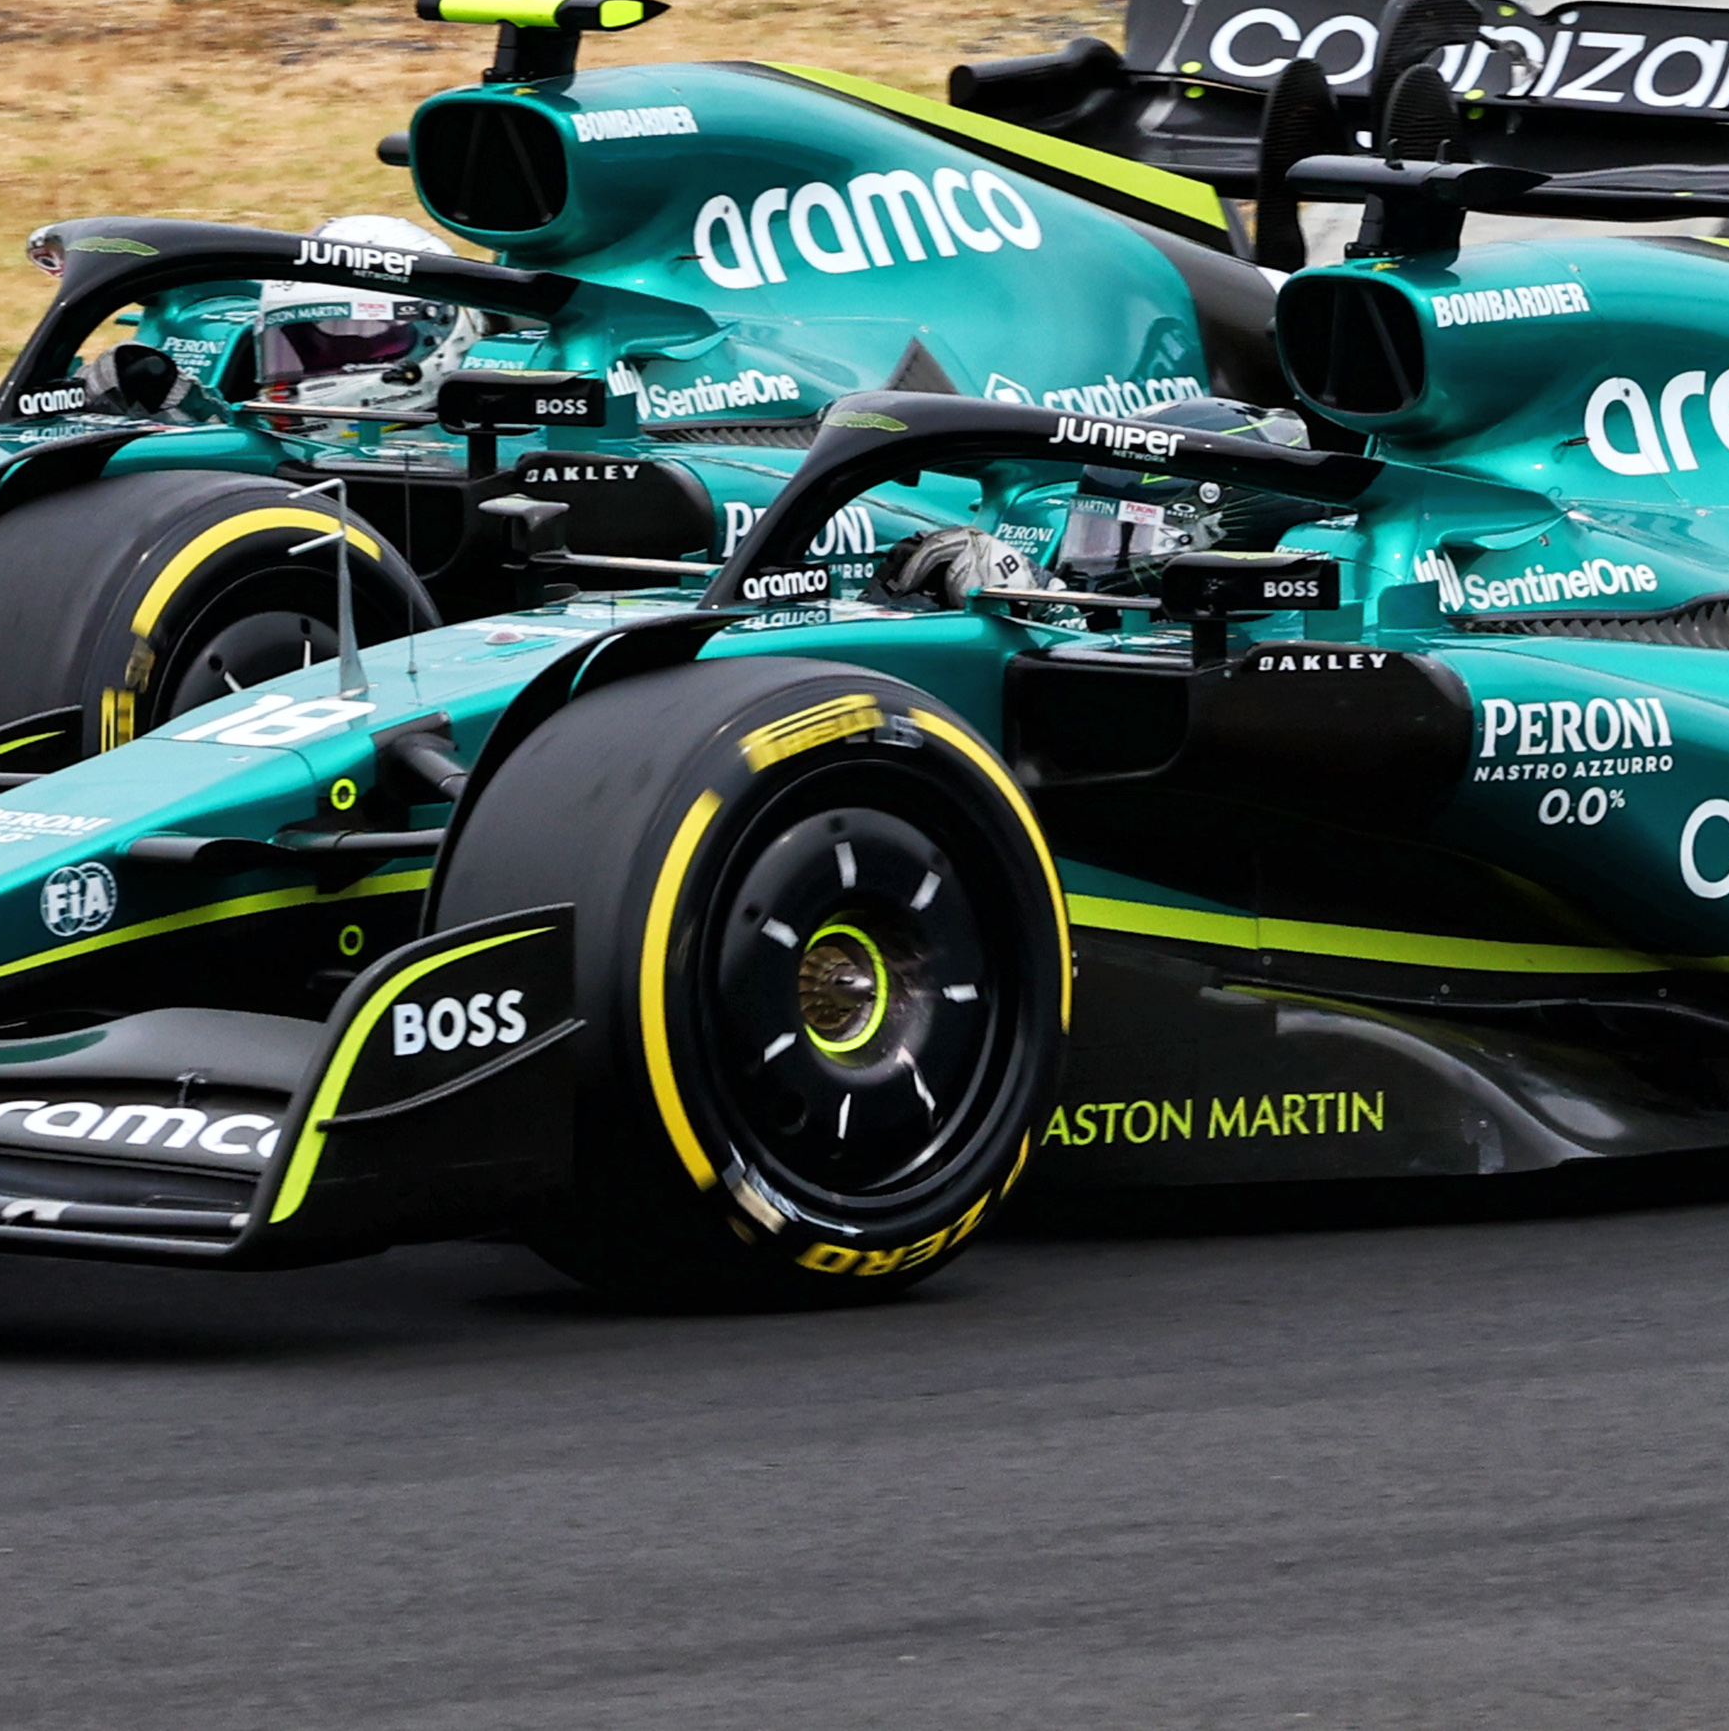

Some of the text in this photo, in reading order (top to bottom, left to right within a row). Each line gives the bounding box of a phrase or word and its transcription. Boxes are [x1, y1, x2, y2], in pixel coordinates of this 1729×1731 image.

[569, 105, 699, 143] BOMBARDIER
[693, 169, 1043, 289] aramco
[1432, 283, 1590, 328] BOMBARDIER
[18, 387, 86, 415] aramco
[535, 399, 588, 415] BOSS
[651, 369, 800, 419] SentinelOne
[525, 465, 640, 483] OAKLEY
[721, 501, 876, 558] PONI
[994, 522, 1055, 543] PERONI
[743, 569, 828, 600] aramco
[995, 554, 1020, 579] 18
[1465, 559, 1658, 611] SentinelOne
[1263, 581, 1320, 598] BOSS
[1258, 653, 1388, 671] OAKLEY
[174, 694, 376, 746] 18
[1479, 698, 1673, 758] PERONI
[1474, 757, 1674, 782] NASTRO AZZURRO
[1537, 788, 1626, 828] 0.0%
[393, 985, 528, 1058] BOSS
[1040, 1088, 1387, 1147] ASTON MARTIN
